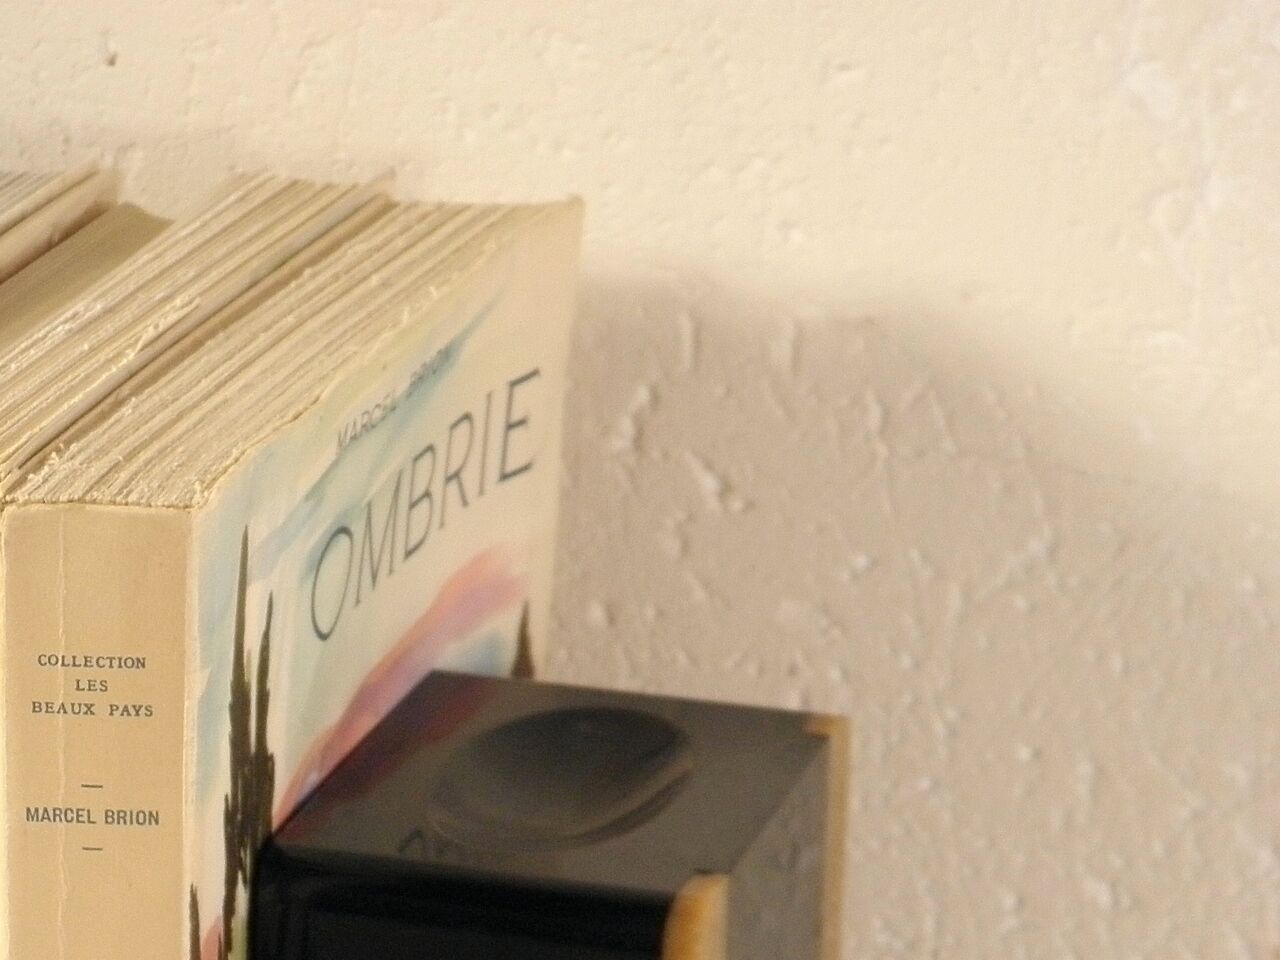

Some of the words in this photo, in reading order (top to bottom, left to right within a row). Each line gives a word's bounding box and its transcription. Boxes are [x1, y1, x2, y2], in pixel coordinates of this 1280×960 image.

[310, 367, 542, 643] OMBRIE
[37, 653, 147, 670] COLLECTION
[75, 678, 109, 693] LES
[31, 701, 96, 716] BEAUX
[108, 704, 154, 718] PAYS
[25, 806, 98, 825] MARCEL
[104, 809, 160, 827] BRION
